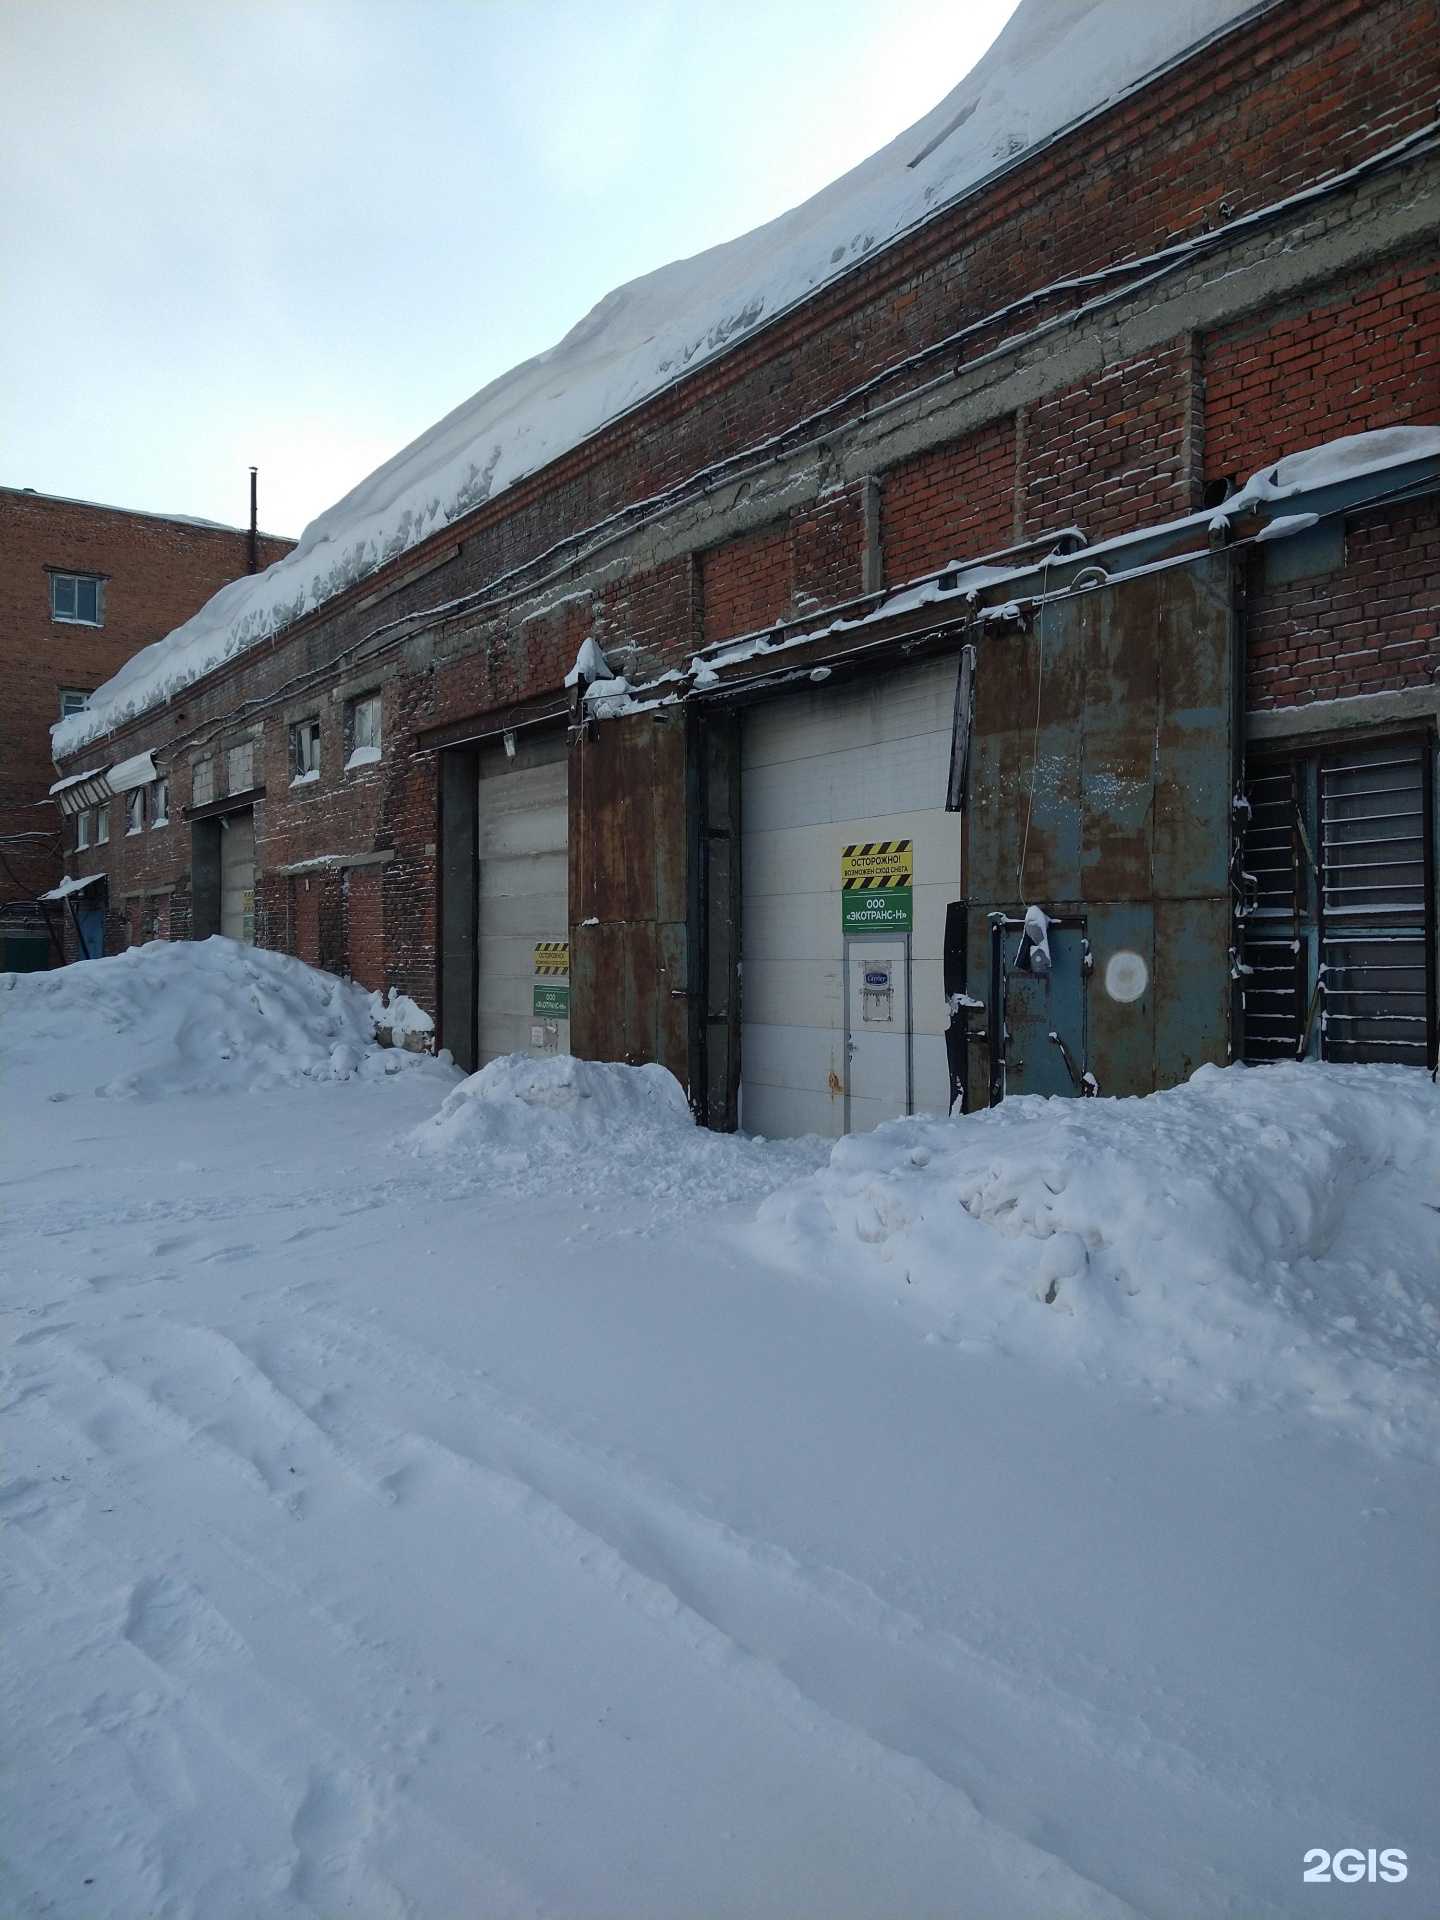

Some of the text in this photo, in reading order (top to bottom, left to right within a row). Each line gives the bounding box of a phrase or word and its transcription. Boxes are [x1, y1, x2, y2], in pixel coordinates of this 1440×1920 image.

[851, 855, 901, 867] ОСТОРОЖНО!
[844, 869, 875, 877] ВОЗМОЖЕН
[891, 866, 908, 874] СНЕГА
[866, 899, 885, 909] ООО
[846, 910, 907, 920] «ЭКОТРАНС-Н»
